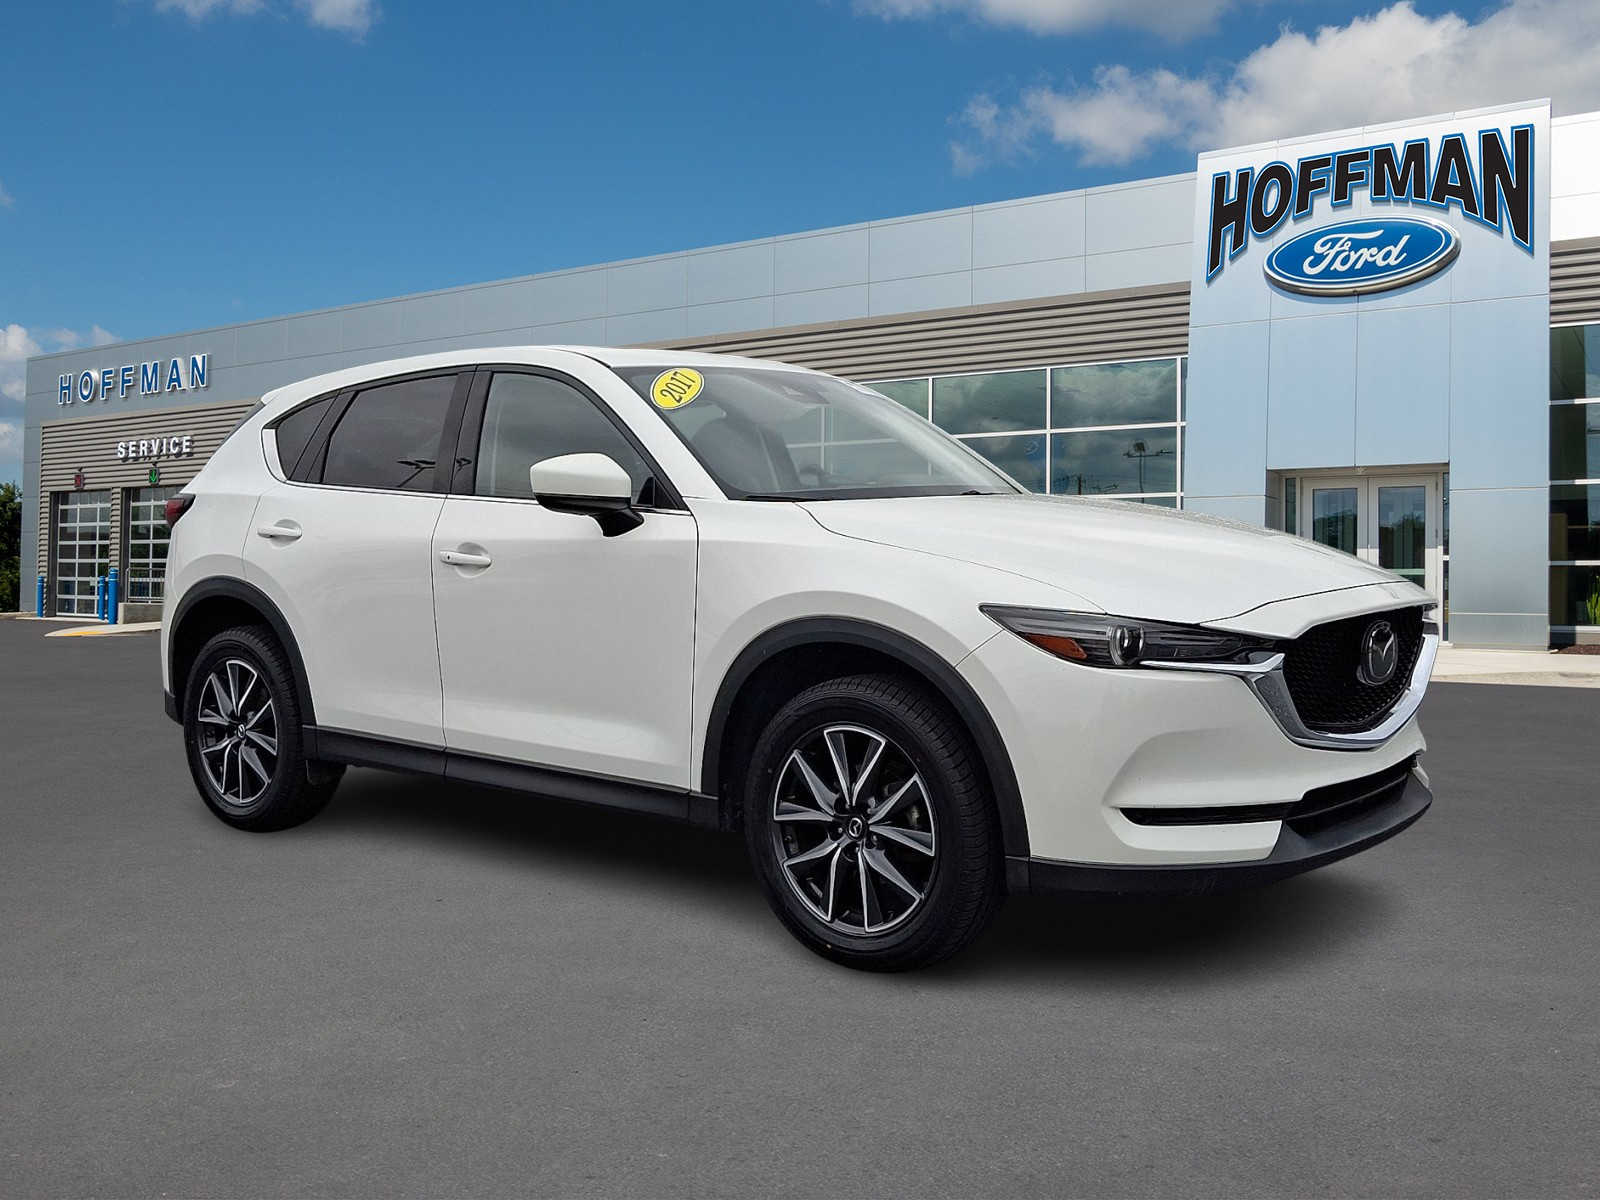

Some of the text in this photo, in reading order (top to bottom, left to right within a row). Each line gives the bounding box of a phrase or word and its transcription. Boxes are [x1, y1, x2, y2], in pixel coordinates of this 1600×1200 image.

[1206, 123, 1535, 283] HOFFMAN
[1303, 229, 1409, 276] Ford
[58, 354, 208, 405] HOFFMAN
[660, 371, 696, 403] 2017
[116, 436, 193, 459] SERVICE
